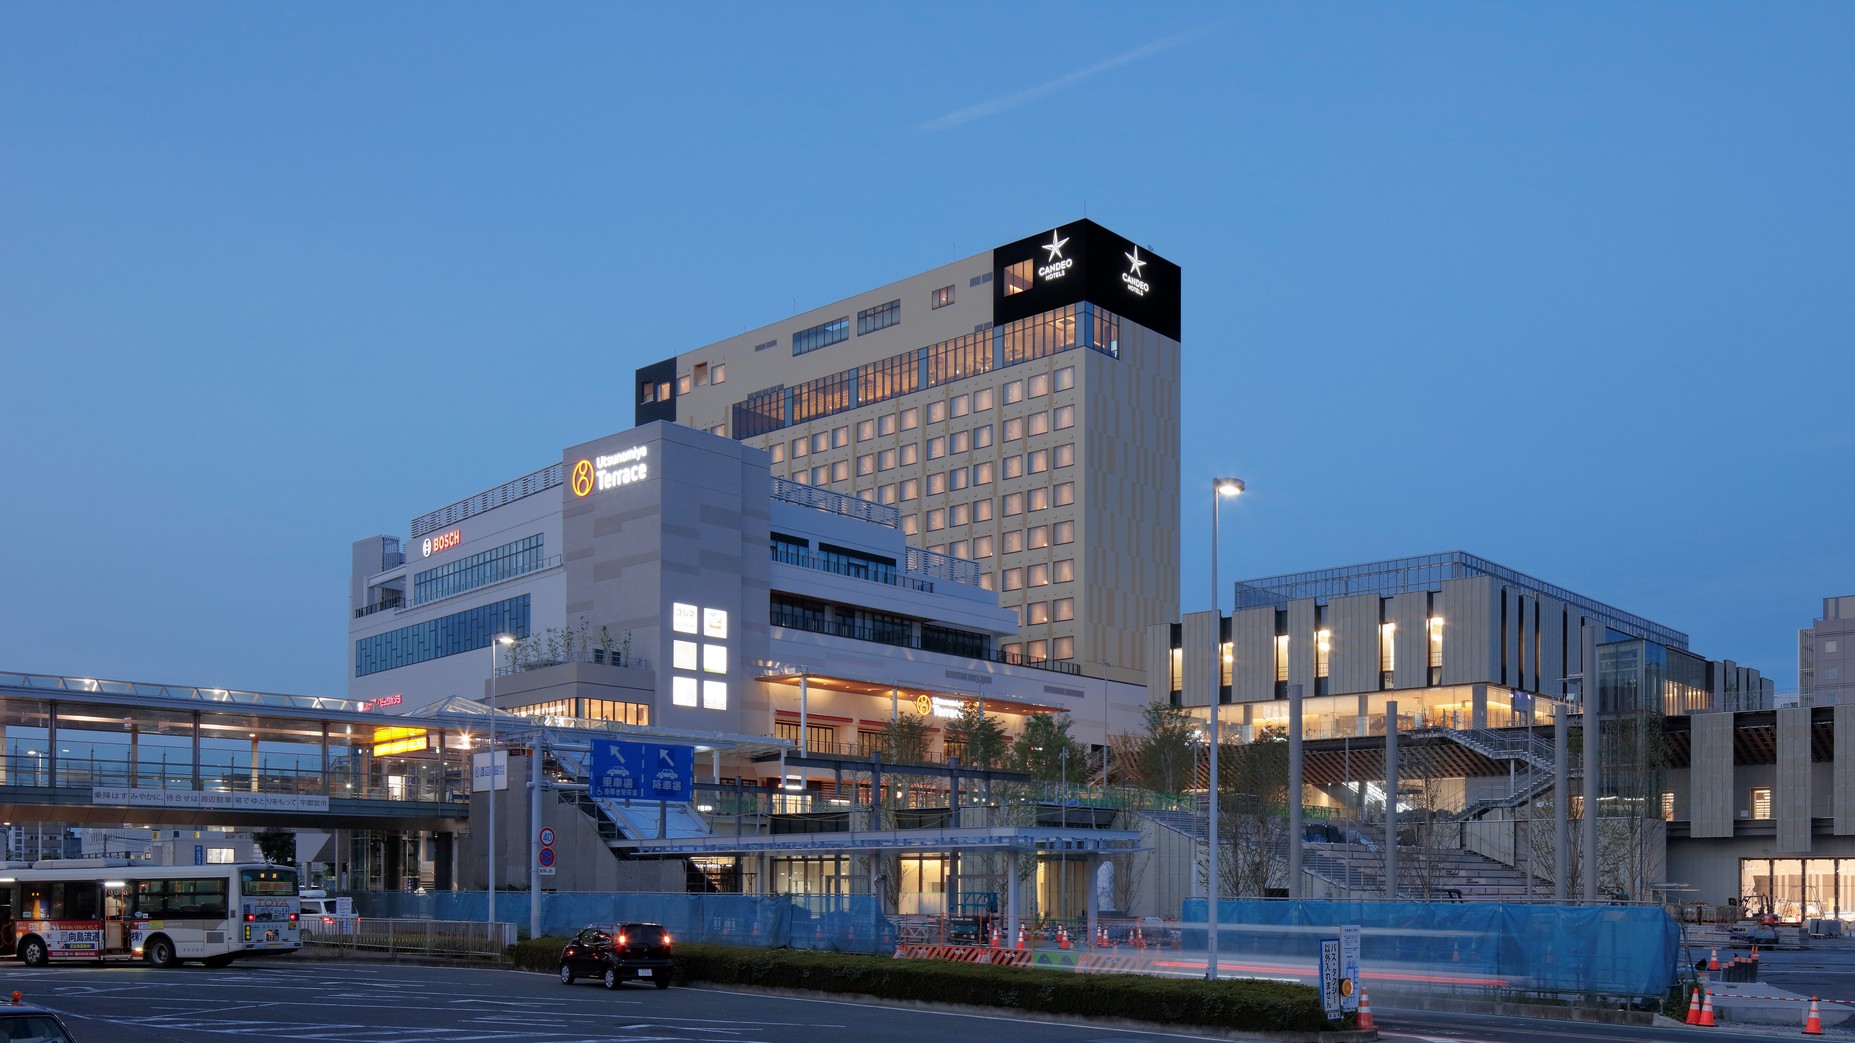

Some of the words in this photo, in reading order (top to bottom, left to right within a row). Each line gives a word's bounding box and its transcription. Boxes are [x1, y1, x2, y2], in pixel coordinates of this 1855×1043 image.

[1038, 259, 1073, 276] CANDEO
[1045, 269, 1066, 281] HOTELS
[1122, 272, 1149, 292] CANDEO
[1127, 284, 1144, 296] HOTELS
[596, 446, 648, 469] Utsunomiya
[596, 463, 647, 491] Terrace
[433, 530, 461, 552] BOSCH
[602, 776, 633, 789] 乗車場
[652, 779, 682, 791] 降車場
[300, 798, 327, 807] 宇都宮市
[543, 832, 552, 842] 40
[256, 898, 289, 907] TOYA
